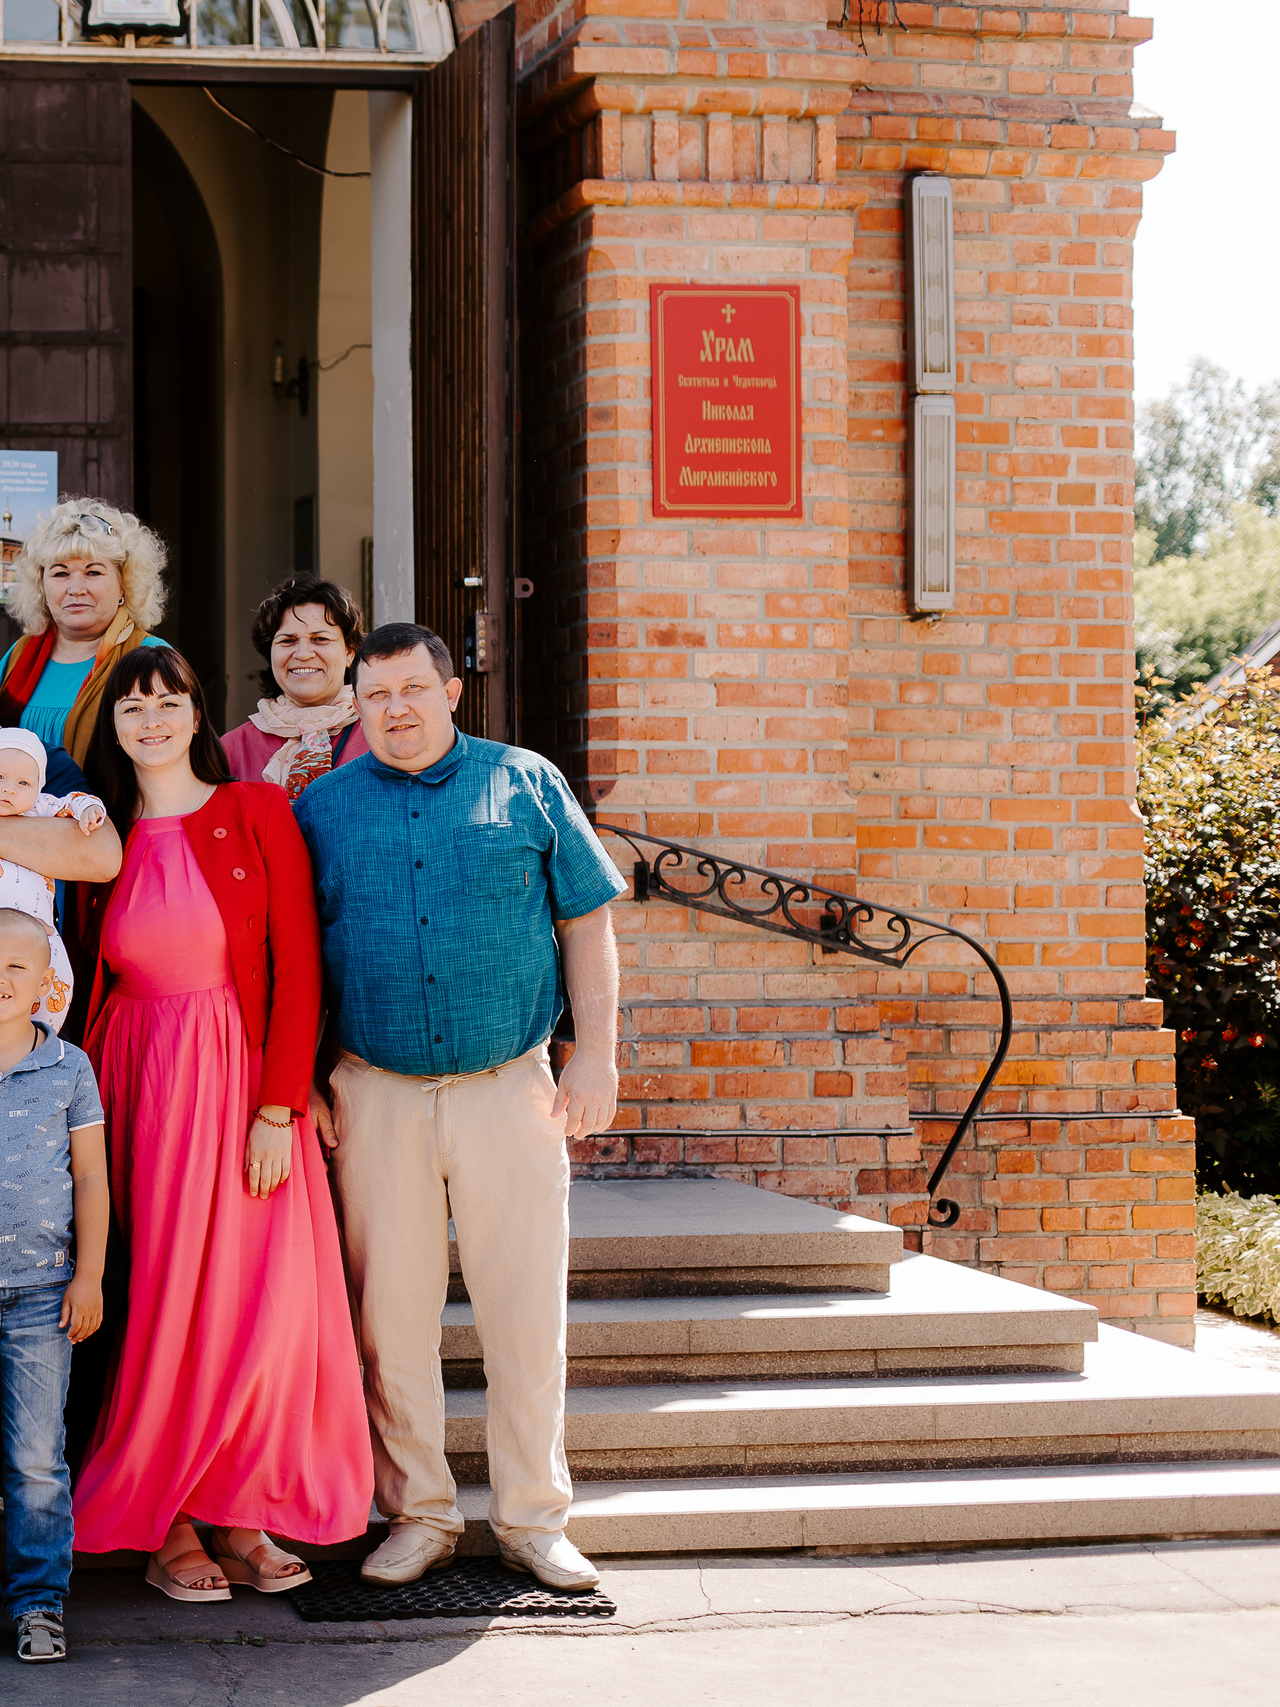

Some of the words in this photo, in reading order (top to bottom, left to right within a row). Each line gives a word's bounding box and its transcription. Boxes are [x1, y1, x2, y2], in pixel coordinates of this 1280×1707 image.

[723, 377, 729, 388] и
[702, 400, 754, 421] Николая
[684, 432, 772, 454] Архиепископа
[679, 465, 778, 488] Мирликийского
